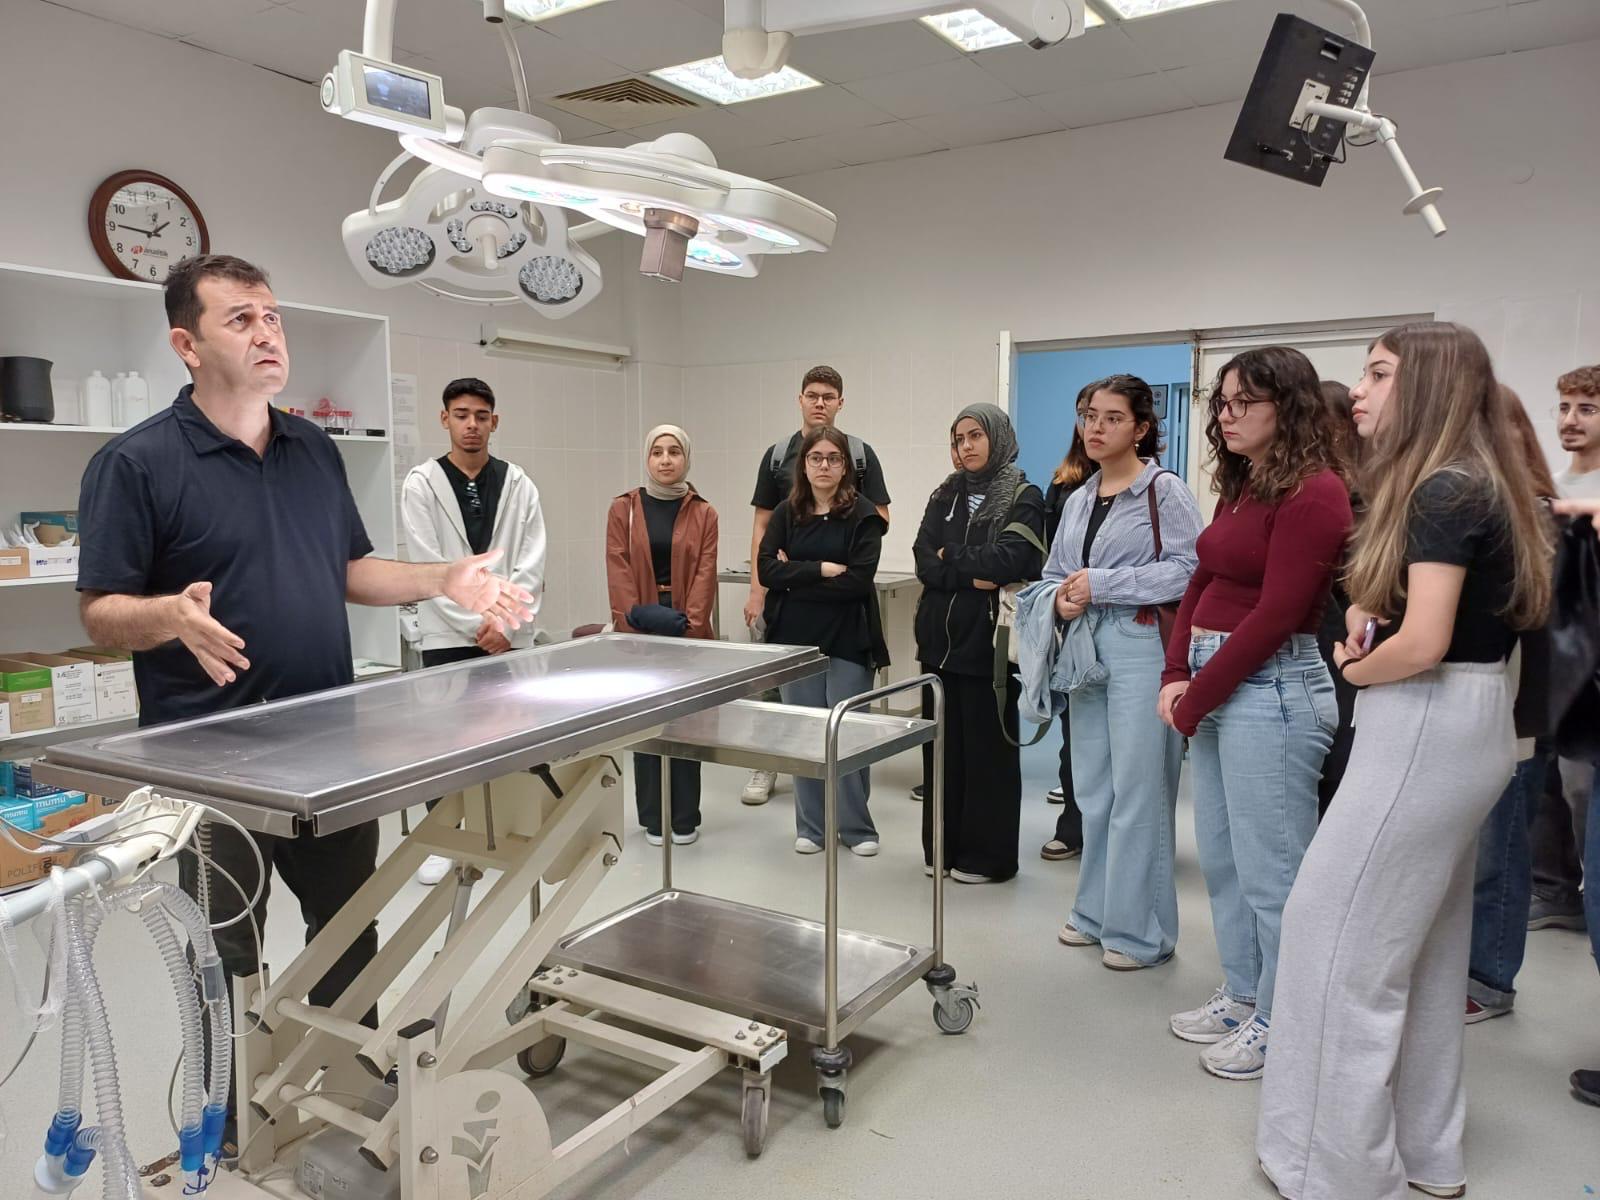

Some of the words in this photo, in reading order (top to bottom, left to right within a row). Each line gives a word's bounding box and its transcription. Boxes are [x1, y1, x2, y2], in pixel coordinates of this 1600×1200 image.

[113, 204, 125, 215] 10
[166, 201, 171, 210] 1
[109, 221, 116, 231] 9
[180, 217, 186, 227] 2
[186, 236, 192, 246] 3
[117, 243, 124, 253] 8
[132, 259, 139, 268] 7
[150, 267, 157, 276] 6
